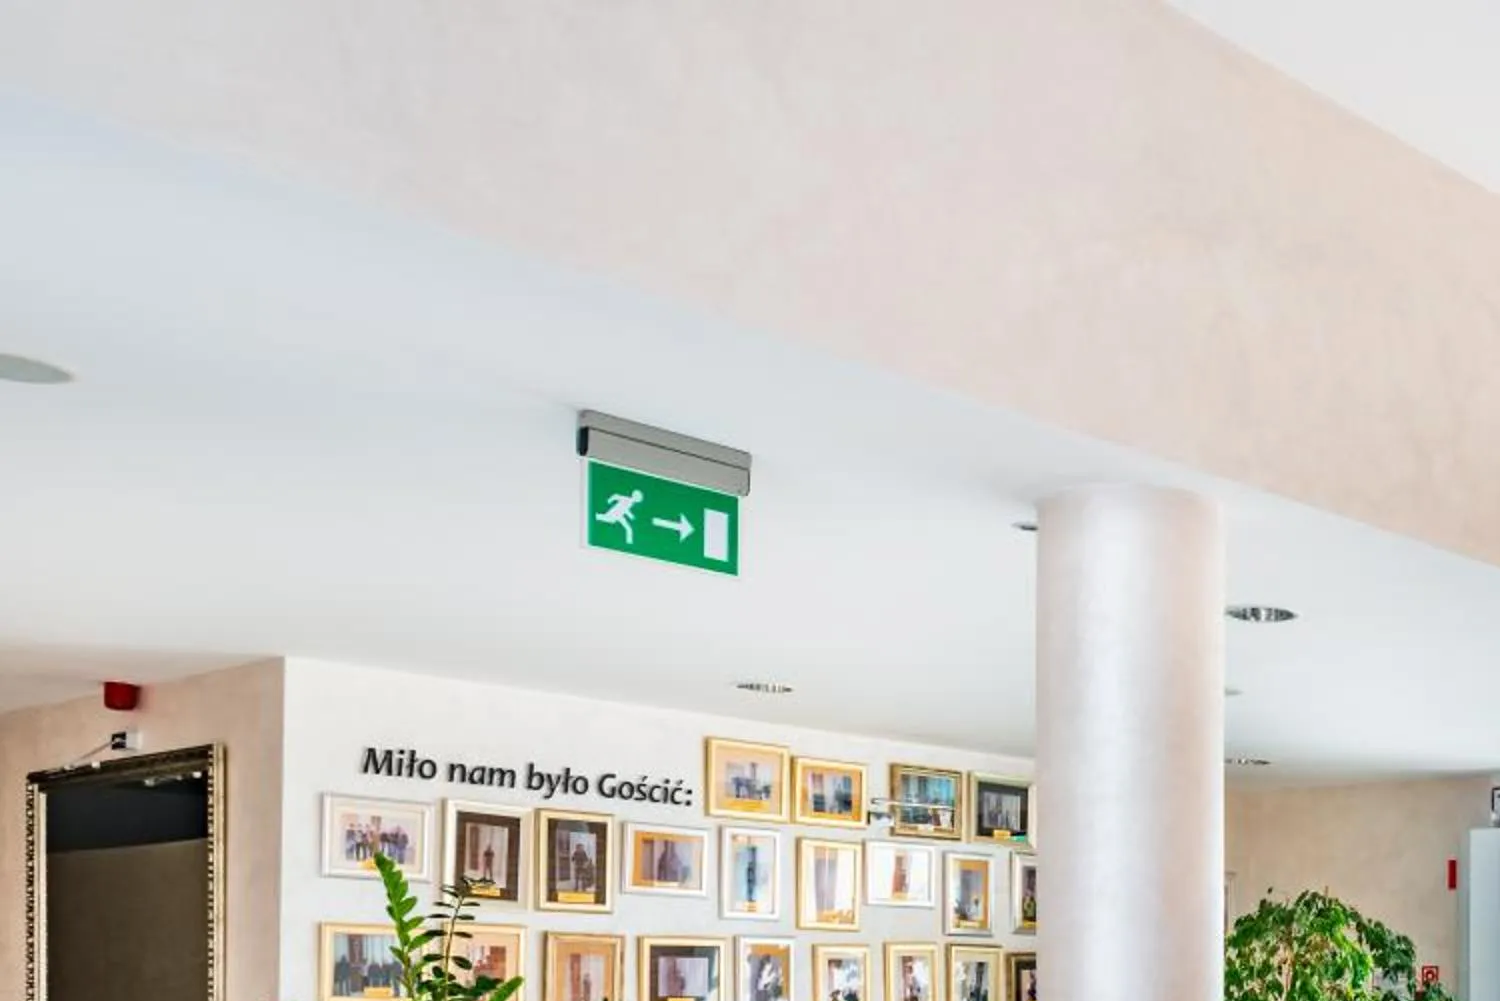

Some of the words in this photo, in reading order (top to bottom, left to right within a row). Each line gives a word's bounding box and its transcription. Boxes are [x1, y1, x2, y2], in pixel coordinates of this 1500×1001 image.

[362, 746, 437, 780] Miło
[448, 761, 516, 789] nam
[527, 762, 589, 799] było
[599, 773, 694, 807] Gościć:
